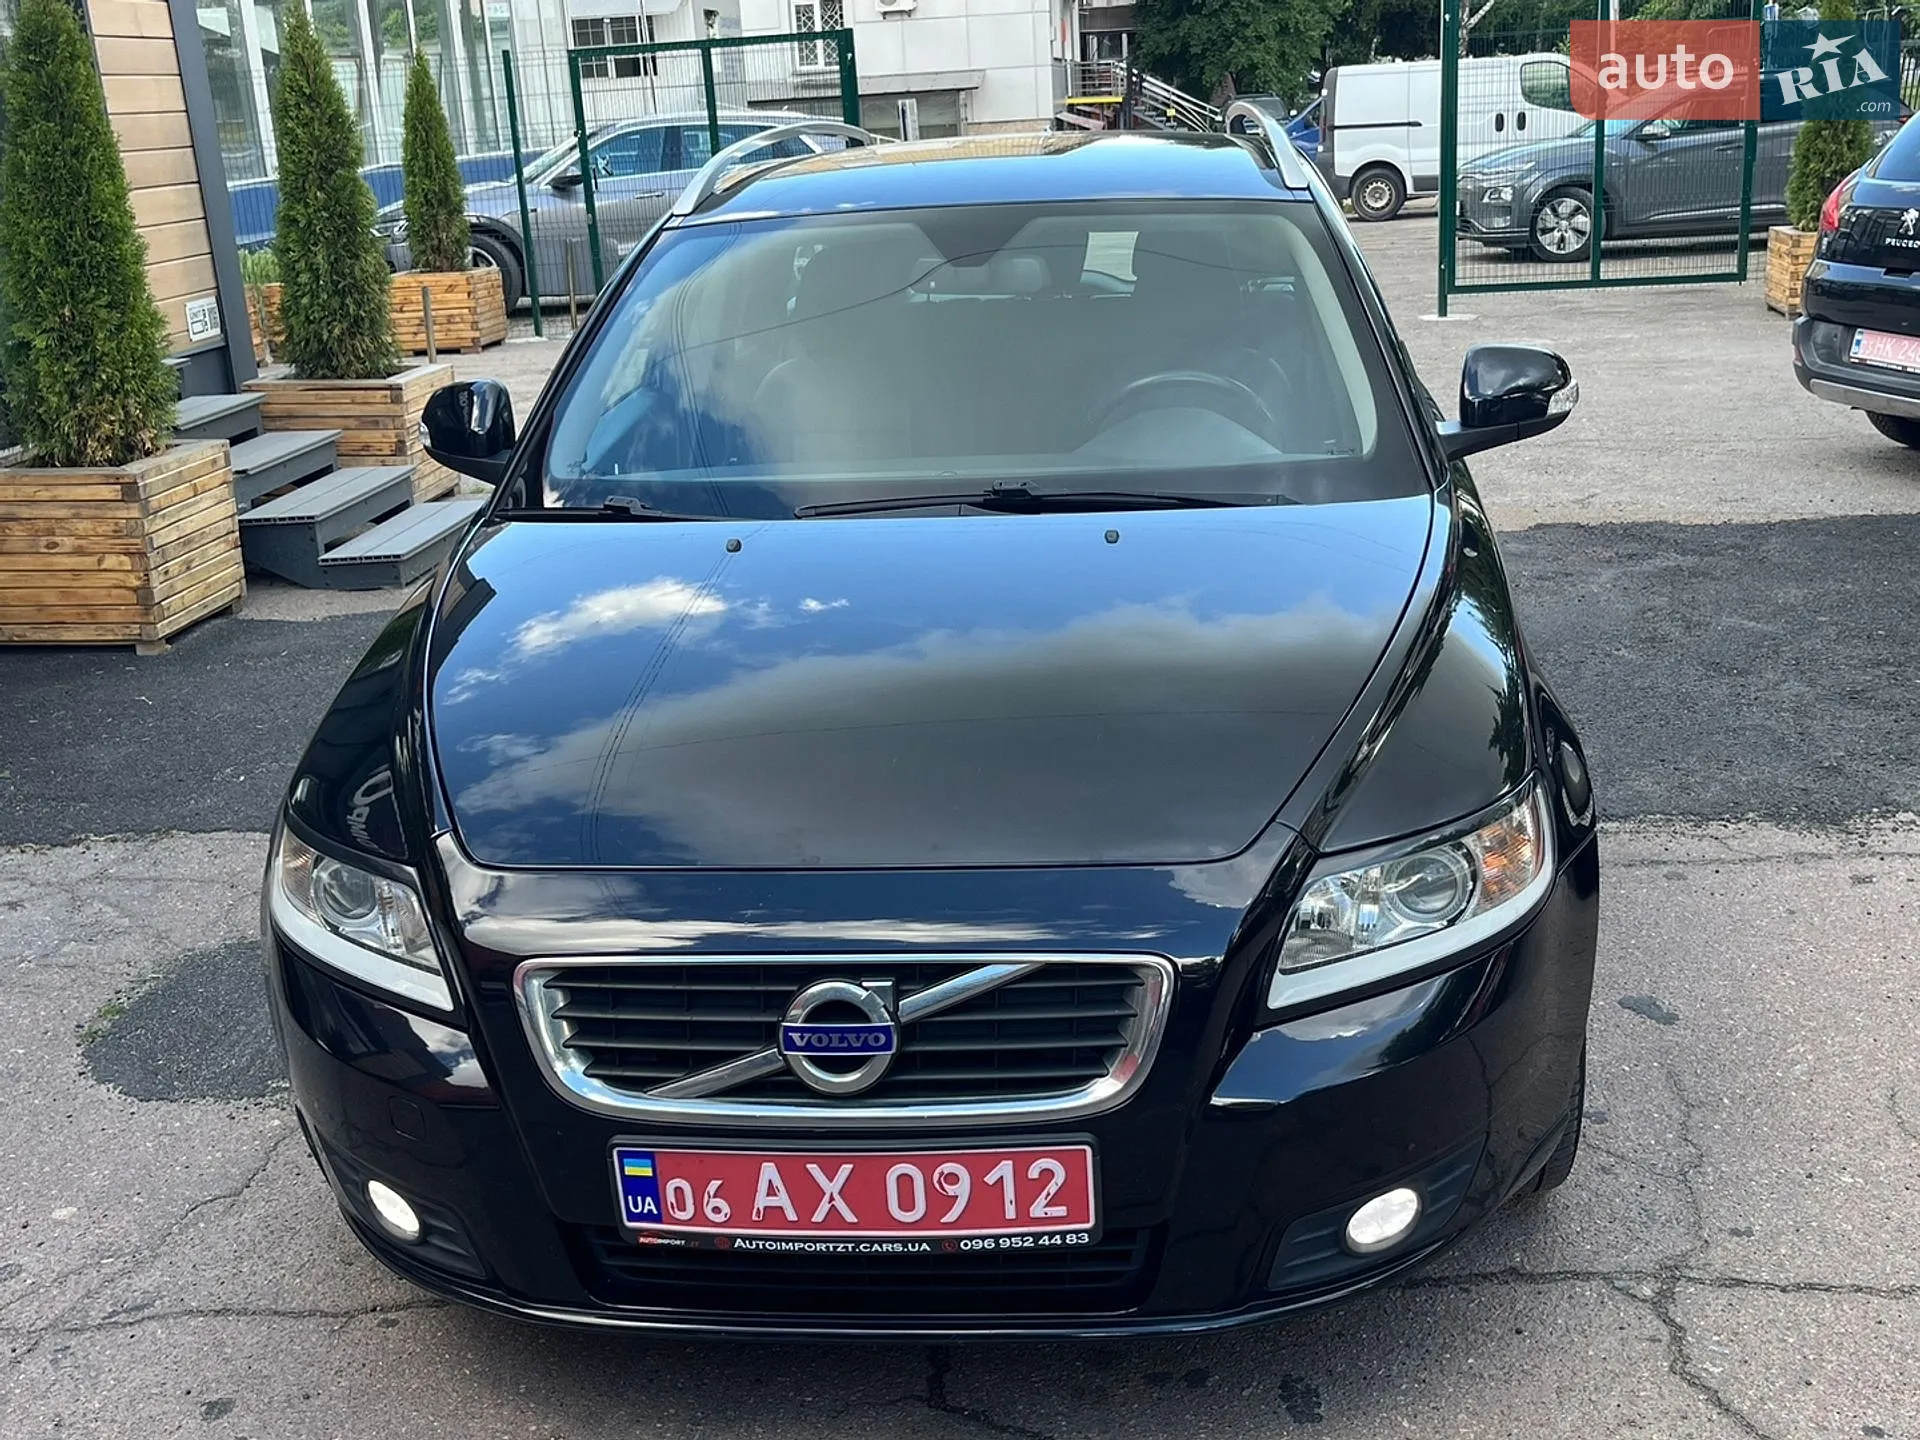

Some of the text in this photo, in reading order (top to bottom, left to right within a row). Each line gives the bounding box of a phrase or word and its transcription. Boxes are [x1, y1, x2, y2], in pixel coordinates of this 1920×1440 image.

[788, 1031, 886, 1048] VOLVO
[665, 1157, 1069, 1224] 06 AX 0912
[627, 1194, 658, 1215] UA
[959, 1232, 1090, 1251] 096 952 44 83
